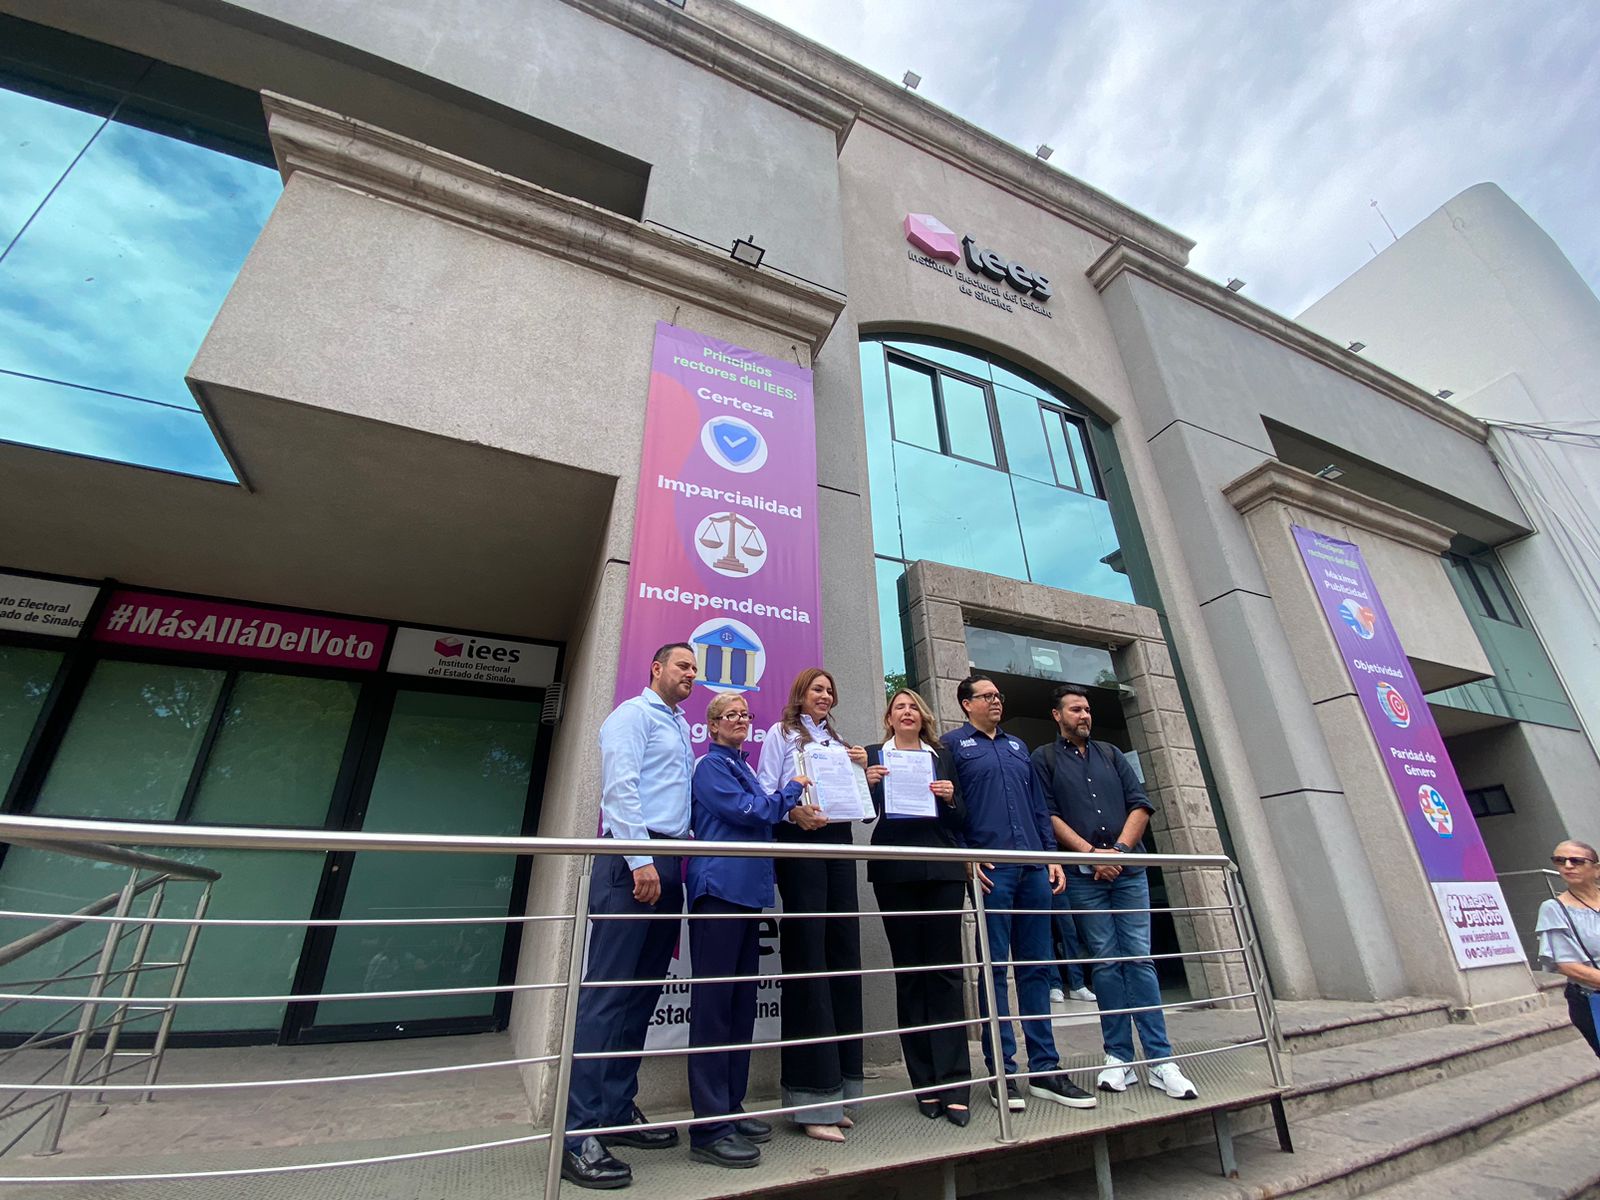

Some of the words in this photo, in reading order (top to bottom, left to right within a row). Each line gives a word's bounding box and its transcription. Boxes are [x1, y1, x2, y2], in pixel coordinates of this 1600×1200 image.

[961, 233, 1054, 302] iees
[908, 250, 953, 277] Instituto
[955, 270, 1000, 296] Electoral
[1003, 290, 1018, 304] del
[1020, 298, 1052, 318] Estado
[960, 284, 972, 296] de
[975, 290, 1013, 312] Sinaloa
[704, 347, 772, 378] Principios
[673, 356, 737, 382] rectores
[740, 374, 761, 390] del
[764, 382, 798, 400] IEES:
[697, 387, 774, 418] Certeza
[658, 474, 802, 519] Imparcialidad
[0, 609, 21, 620] ado
[24, 612, 39, 622] de
[18, 598, 70, 614] Electoral
[639, 582, 810, 624] Independencia
[107, 604, 374, 660] #MásAlláDelVoto
[438, 658, 474, 670] Instituto
[475, 662, 510, 674] Electoral
[467, 640, 520, 663] iees
[428, 668, 442, 676] del
[444, 669, 472, 680] Estado
[474, 672, 484, 681] de
[486, 674, 516, 684] Sinaloa
[1354, 659, 1404, 678] Objetividad
[1390, 748, 1425, 762] Paridad
[1426, 752, 1436, 764] de
